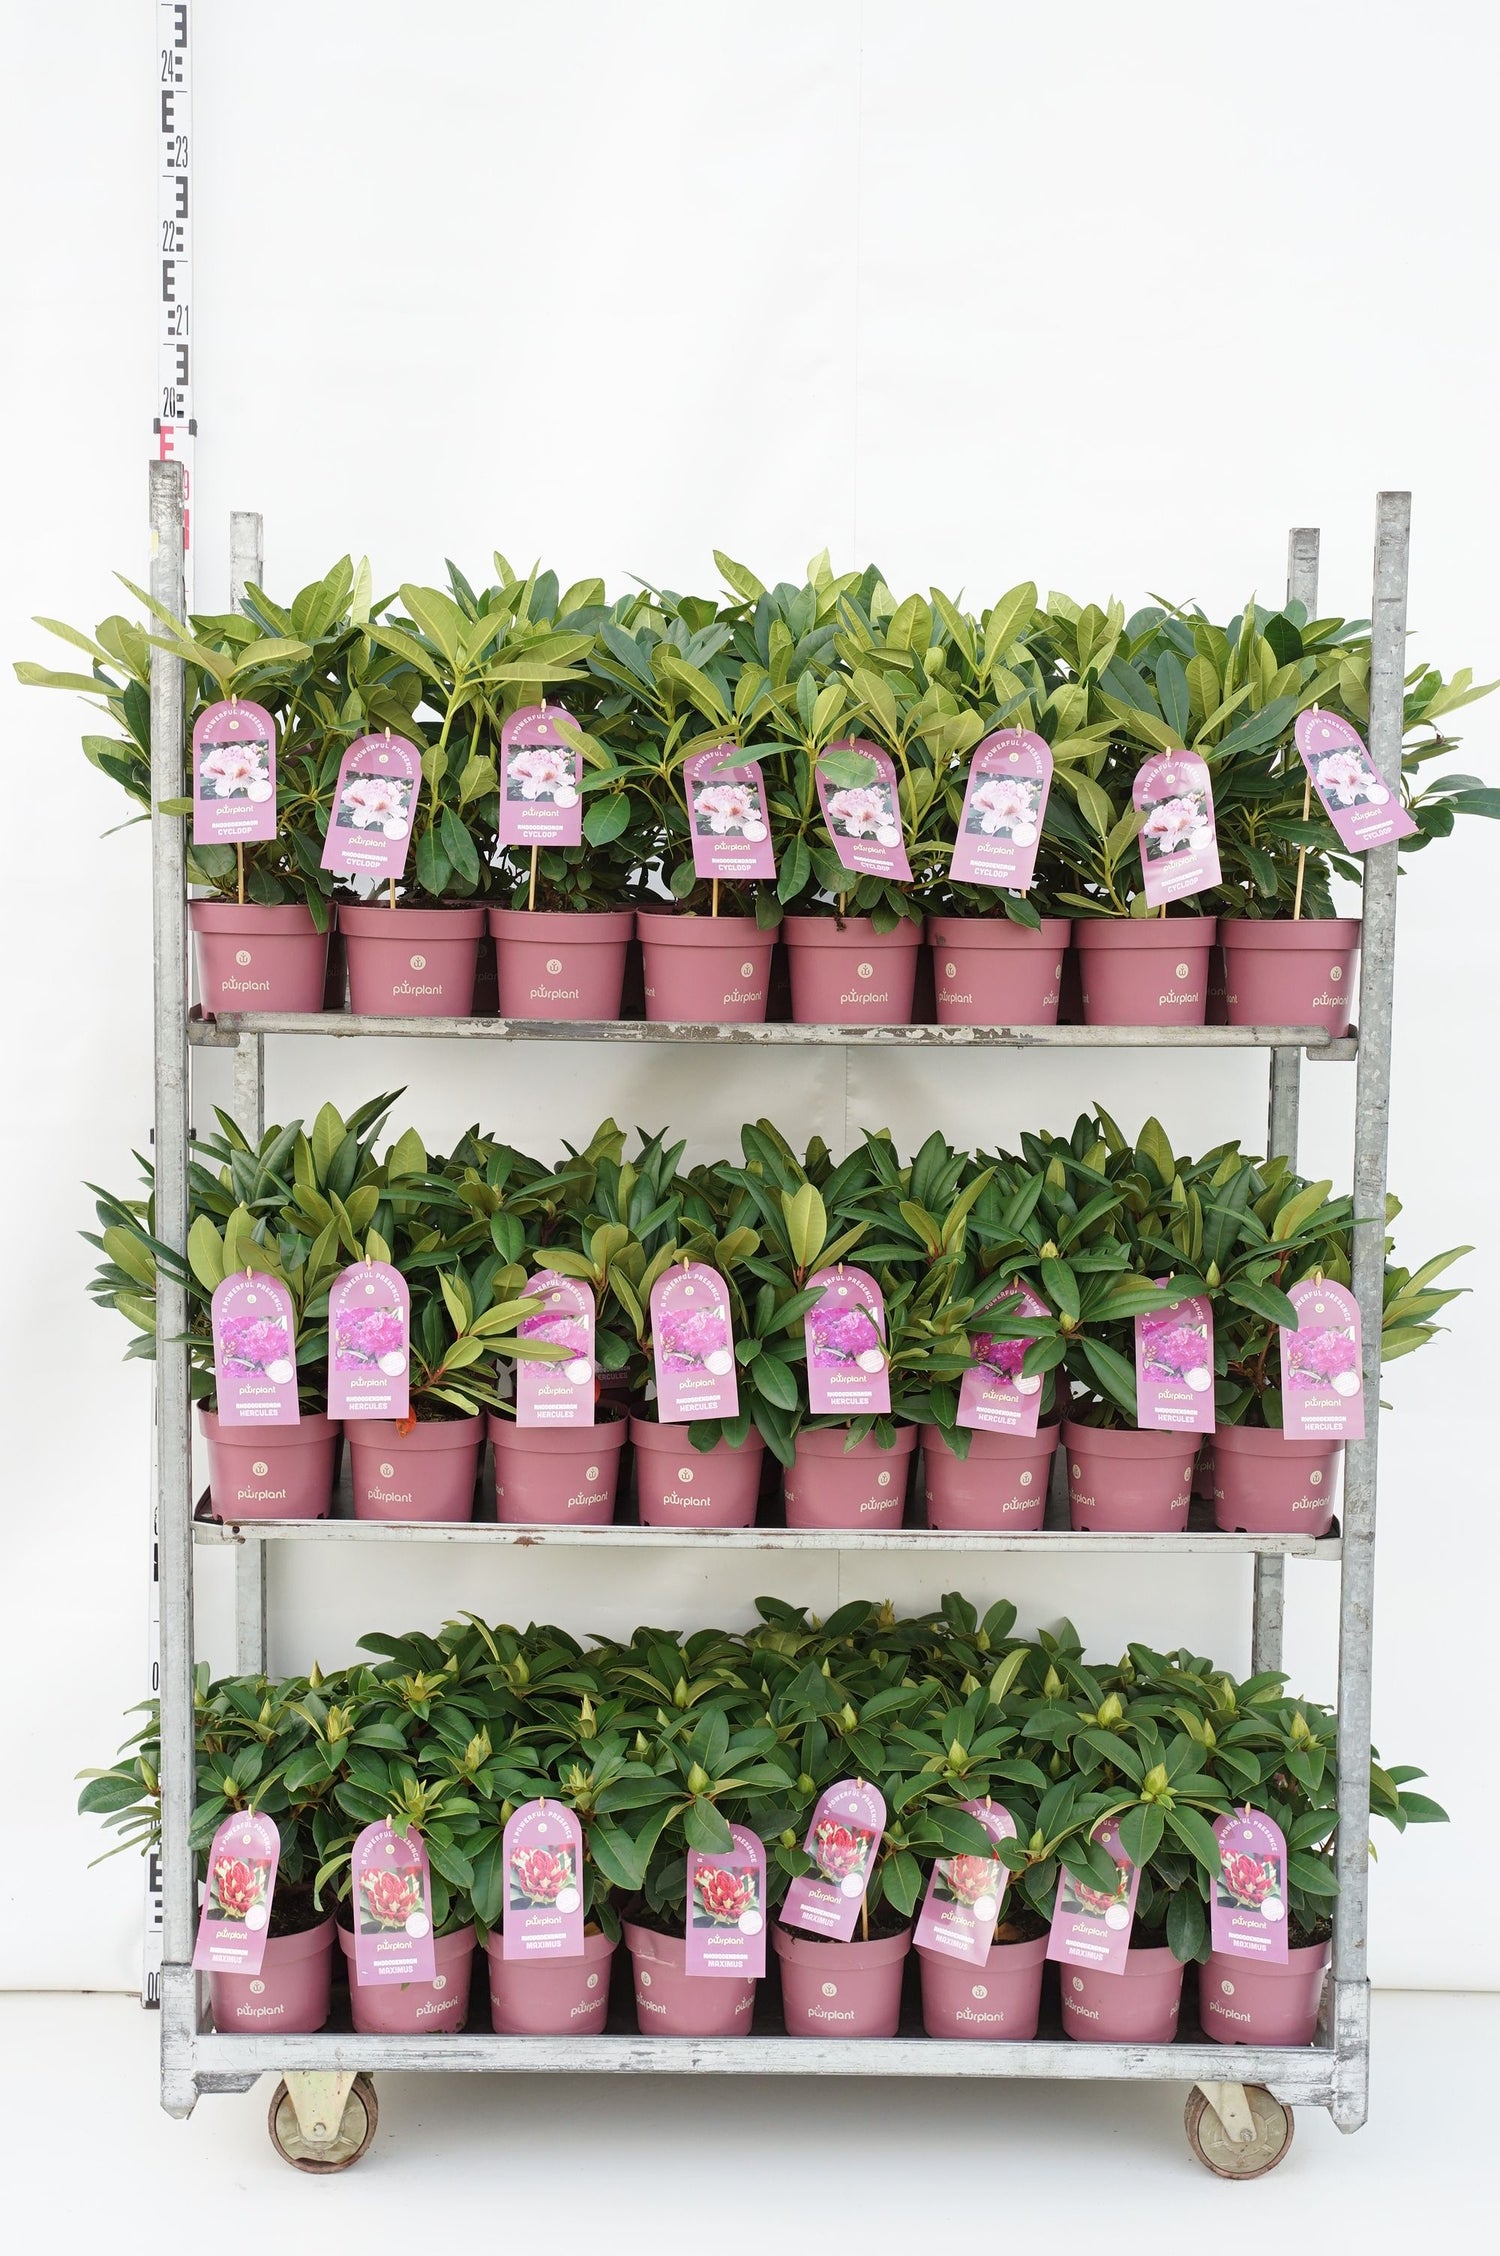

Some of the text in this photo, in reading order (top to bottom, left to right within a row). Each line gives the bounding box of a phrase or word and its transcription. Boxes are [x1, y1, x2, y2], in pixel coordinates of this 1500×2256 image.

[161, 50, 174, 82] 24
[175, 136, 188, 168] 23
[162, 220, 175, 252] 22
[176, 305, 189, 336] 21
[163, 387, 175, 418] 20
[206, 710, 237, 733] POWERFUL
[240, 710, 266, 736] PRESENCE
[515, 714, 545, 736] POWERFUL
[354, 743, 388, 762] POWERFUL
[392, 745, 413, 775] PRESENCE
[697, 752, 723, 772] POWERFUL
[986, 740, 1019, 762] POWERFUL
[1022, 742, 1043, 774] PRESENCE
[218, 827, 252, 836] CYCLOOP
[346, 858, 380, 868] CYCLOOP
[975, 868, 1008, 878] CYCLOOP
[1168, 877, 1199, 893] CYCLOOP
[225, 1282, 253, 1306] POWERFUL
[257, 1283, 283, 1312] PRESENCE
[342, 1273, 373, 1298] POWERFUL
[376, 1273, 400, 1303] PRESENCE
[562, 1282, 585, 1310] PRESENCE
[664, 1274, 691, 1300] POWERFUL
[694, 1274, 720, 1301] PRESENCE
[848, 1276, 874, 1303] PRESENCE
[1325, 1291, 1351, 1321] PRESENCE
[680, 1403, 718, 1412] HERCULES
[978, 1414, 1016, 1425] HERCULES
[829, 1791, 860, 1809] POWERFUL
[862, 1793, 877, 1827] PRESENCE
[515, 1811, 545, 1836] POWERFUL
[548, 1811, 572, 1839] PRESENCE
[1253, 1820, 1277, 1851] PRESENCE
[363, 1831, 392, 1857] POWERFUL
[733, 1834, 757, 1863] PRESENCE
[802, 1913, 834, 1927] MAXIMUS
[526, 1941, 561, 1949] MAXIMUS
[1069, 1947, 1103, 1961] MAXIMUS
[1233, 1940, 1267, 1951] MAXIMUS
[379, 1966, 413, 1975] MAXIMUS
[708, 1960, 743, 1968] MAXIMUS
